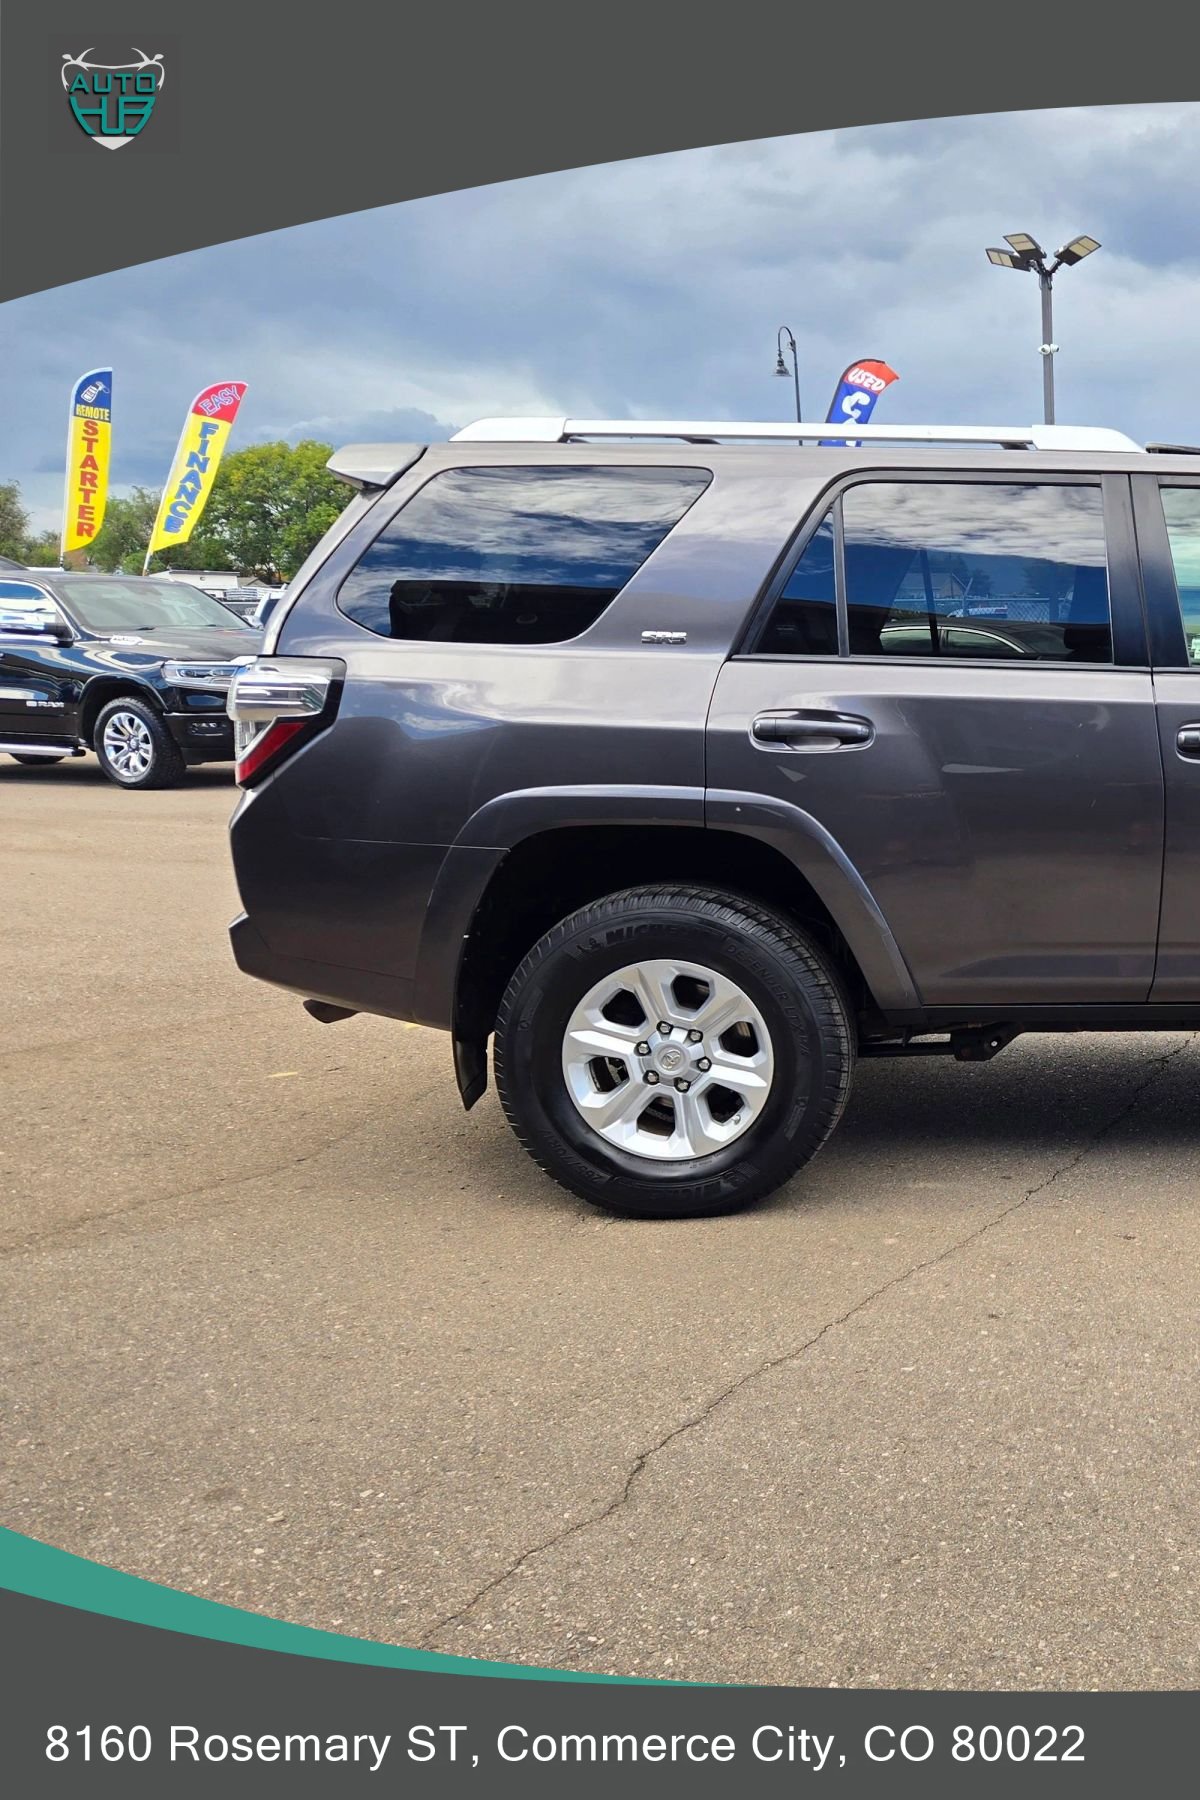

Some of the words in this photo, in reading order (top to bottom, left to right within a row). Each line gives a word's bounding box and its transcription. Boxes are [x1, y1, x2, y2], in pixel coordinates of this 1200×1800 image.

[847, 366, 886, 392] USED
[75, 403, 110, 422] REMOTE
[199, 384, 242, 417] EASY
[76, 419, 100, 538] STARTER
[162, 421, 220, 534] FINANCE
